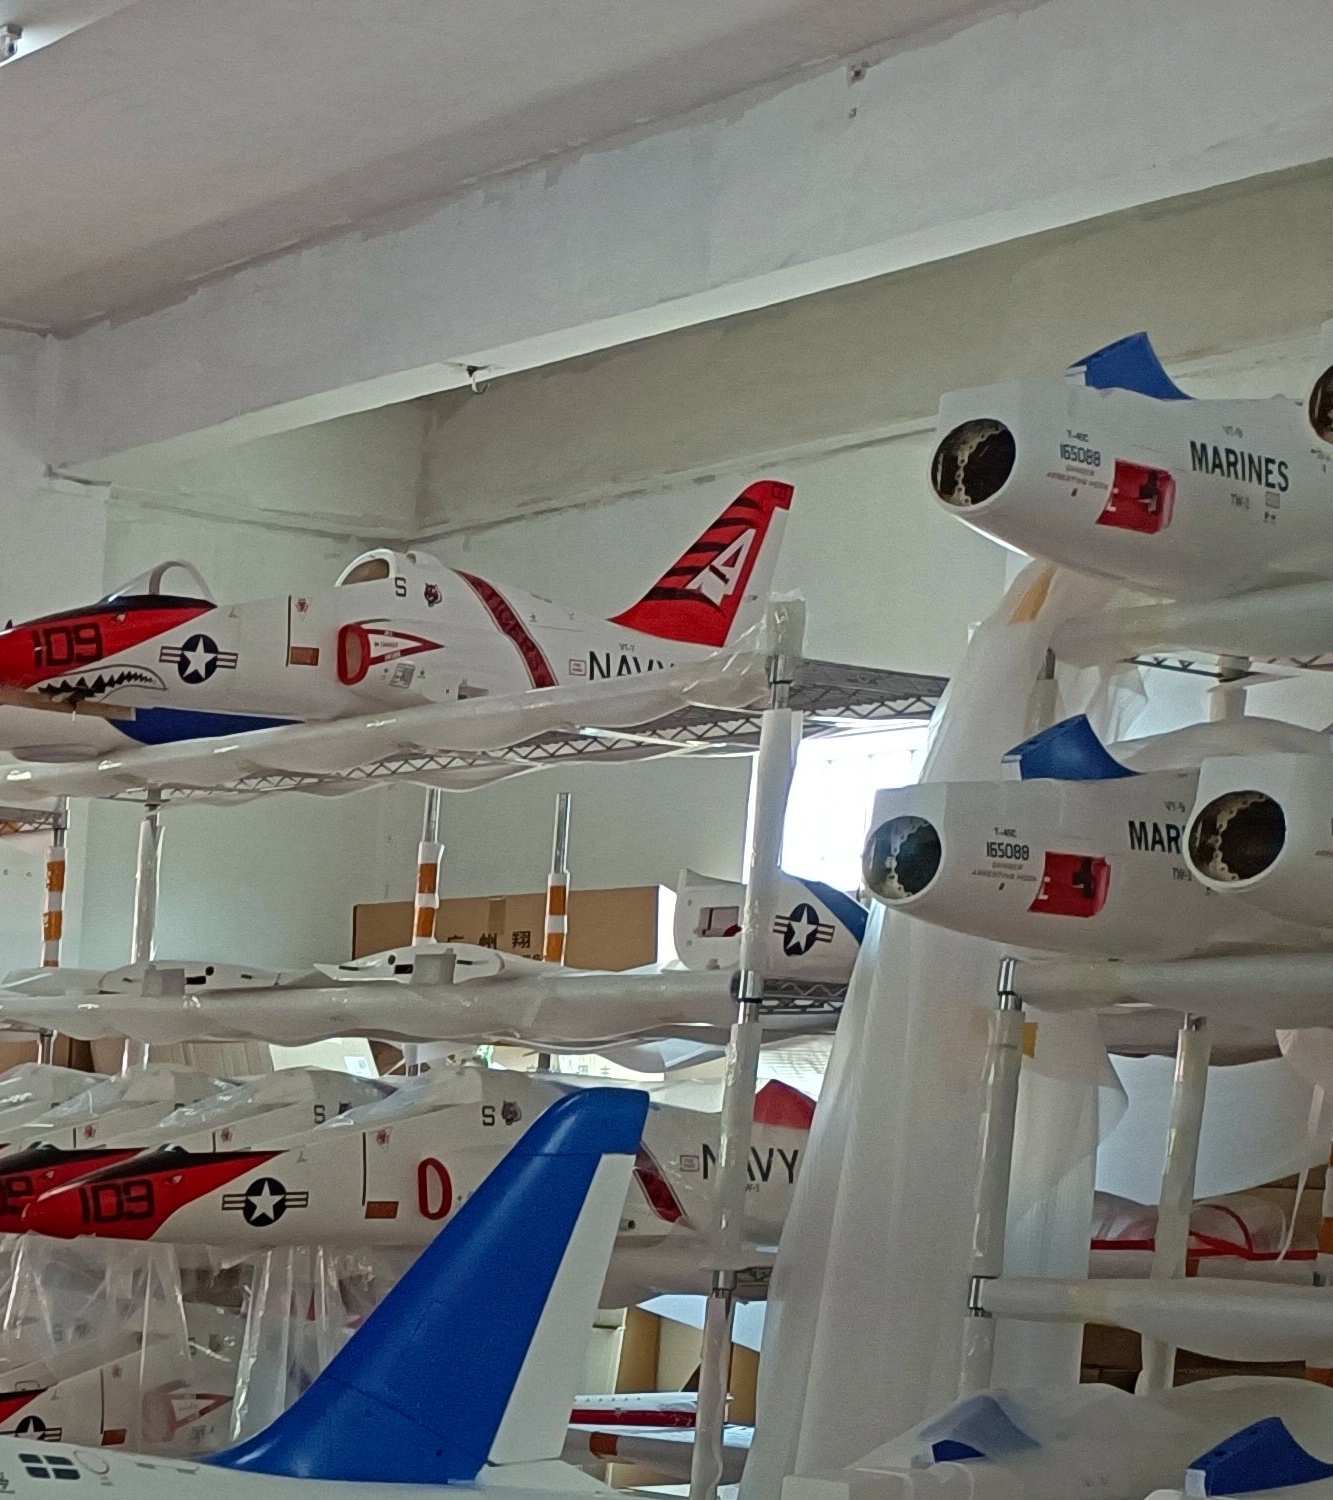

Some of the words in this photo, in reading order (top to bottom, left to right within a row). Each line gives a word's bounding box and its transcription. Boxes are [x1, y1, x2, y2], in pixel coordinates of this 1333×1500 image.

[1189, 440, 1290, 492] MARINES
[395, 577, 408, 598] S
[32, 622, 104, 669] 109
[986, 840, 1031, 861] 165088
[313, 1104, 326, 1125] S
[481, 1105, 496, 1127] S
[78, 1178, 155, 1225] 109
